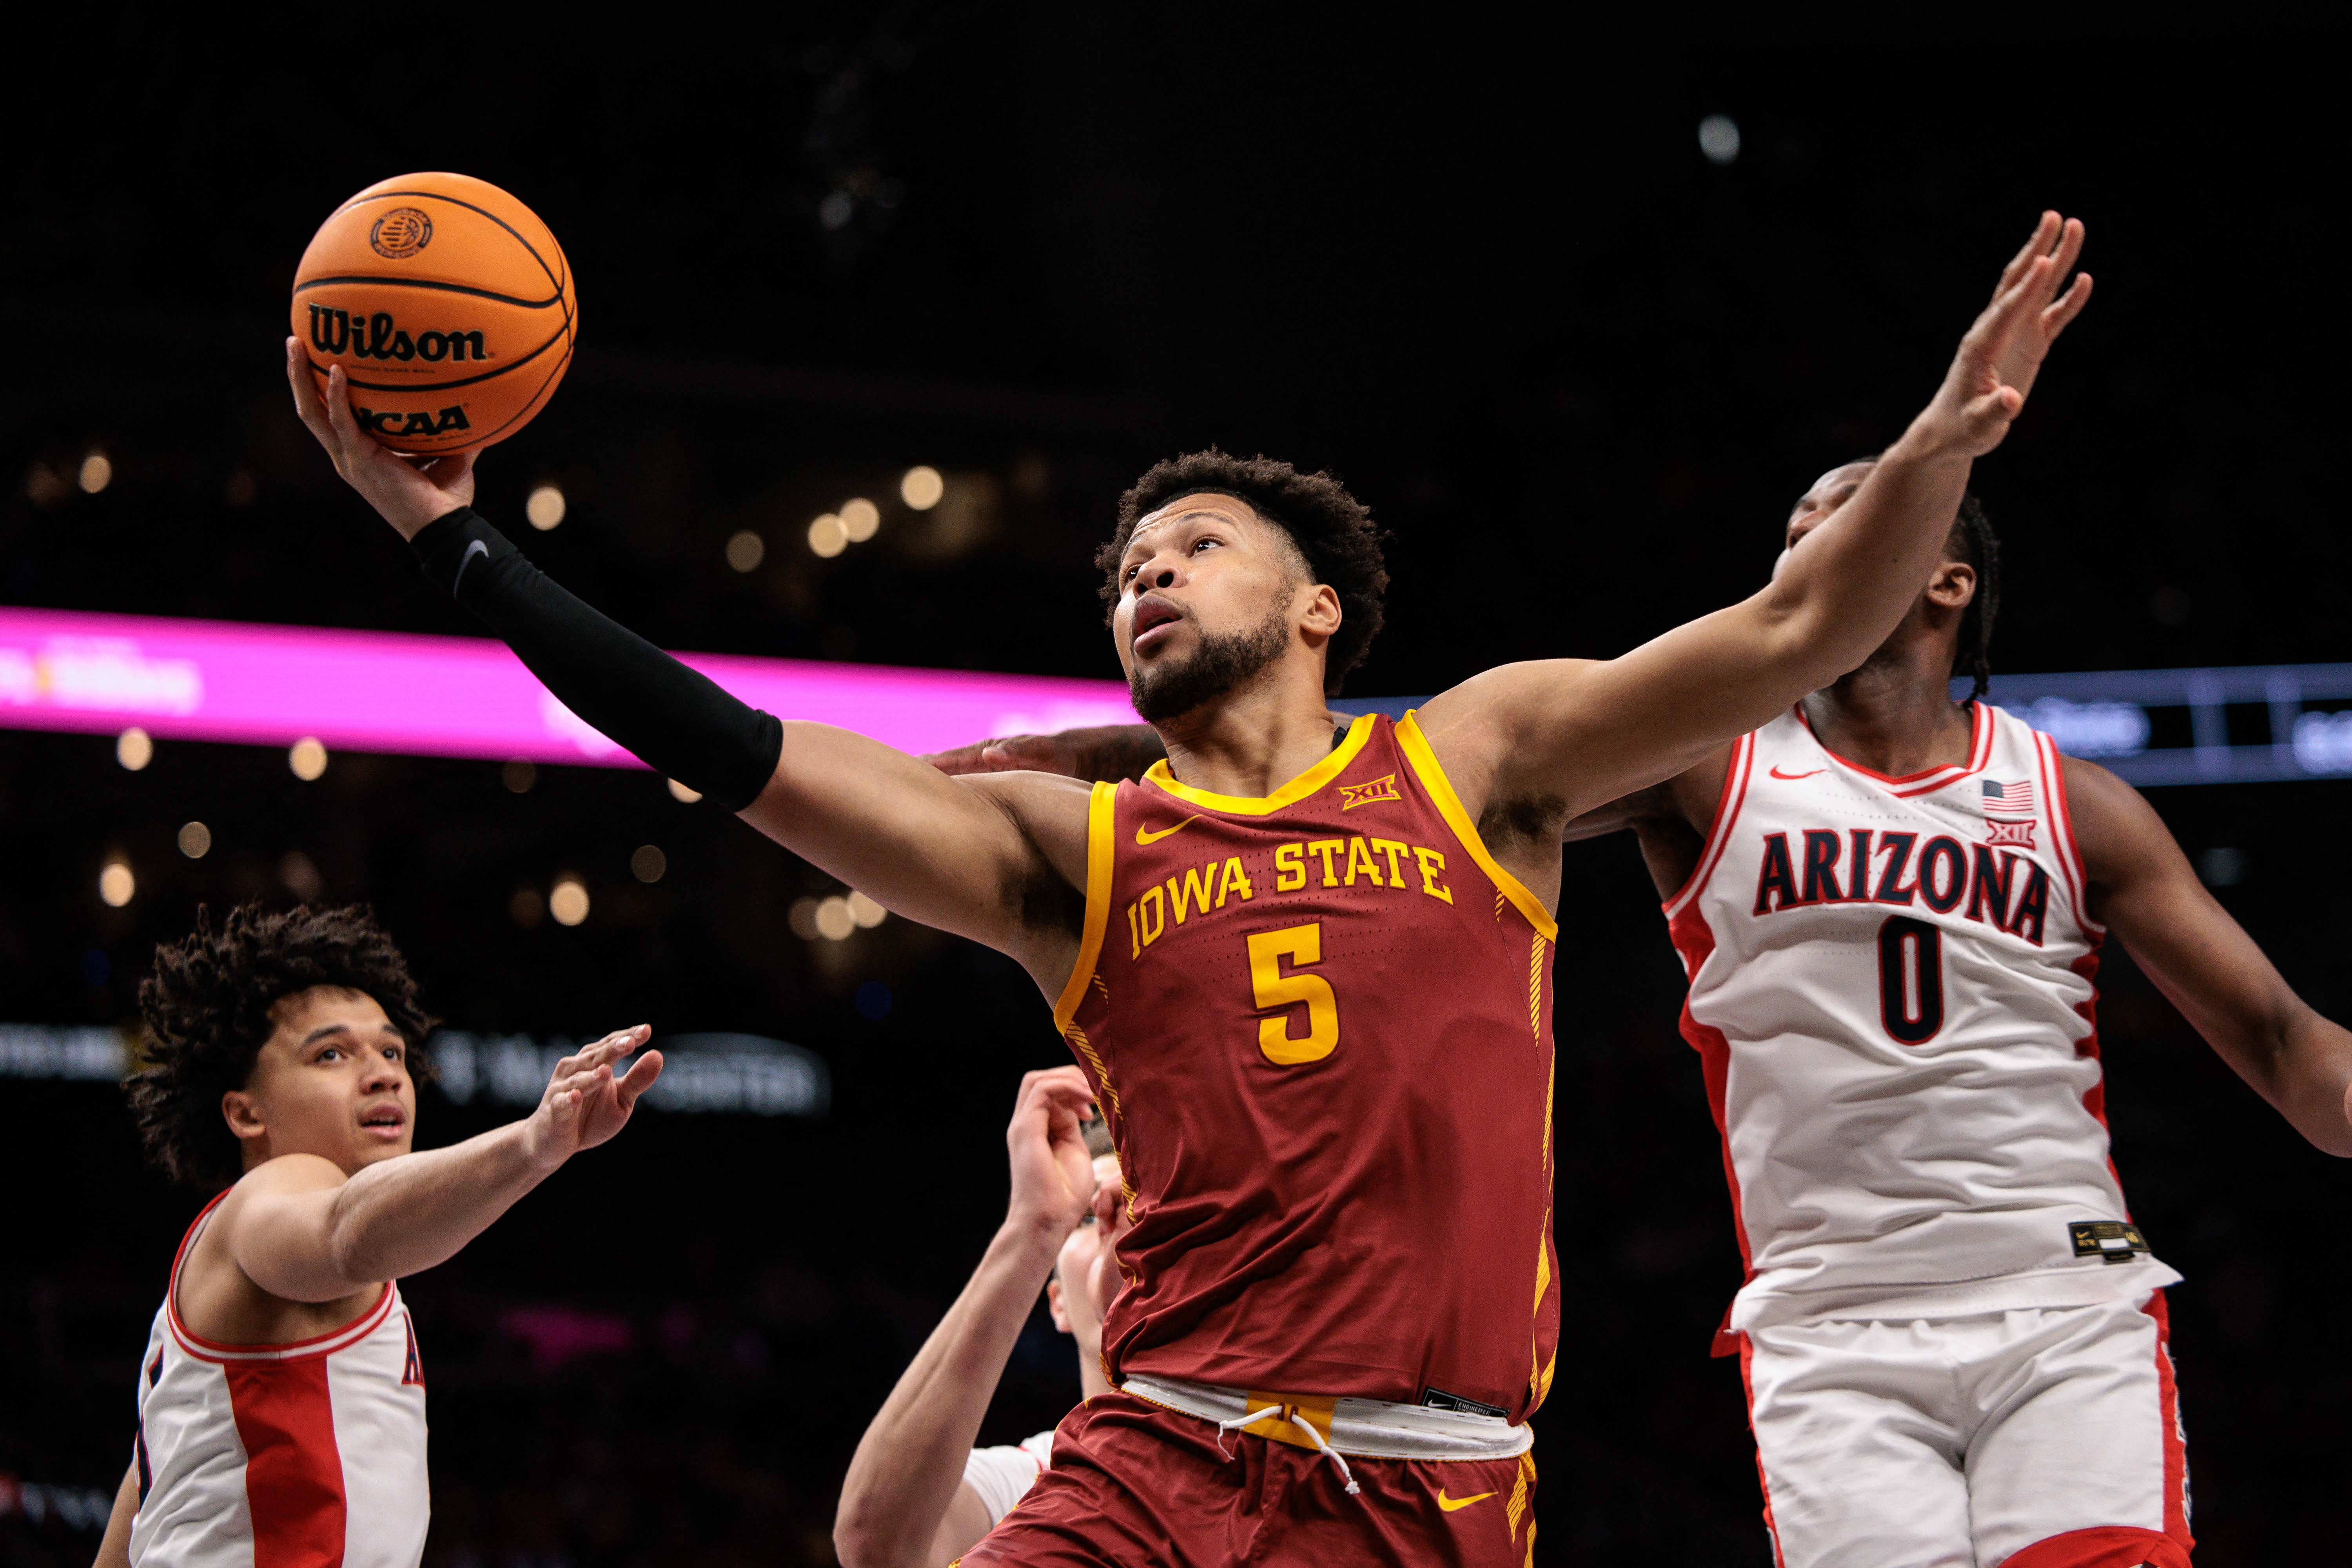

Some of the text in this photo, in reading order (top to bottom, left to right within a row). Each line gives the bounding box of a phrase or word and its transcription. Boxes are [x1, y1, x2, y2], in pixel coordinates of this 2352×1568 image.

[309, 302, 488, 361] Wilson
[1753, 829, 2049, 947] ARIZONA
[1986, 818, 2035, 848] XII
[1127, 837, 1454, 961] IOWA STATE
[1247, 922, 1340, 1066] 5
[1878, 915, 1944, 1045] 0
